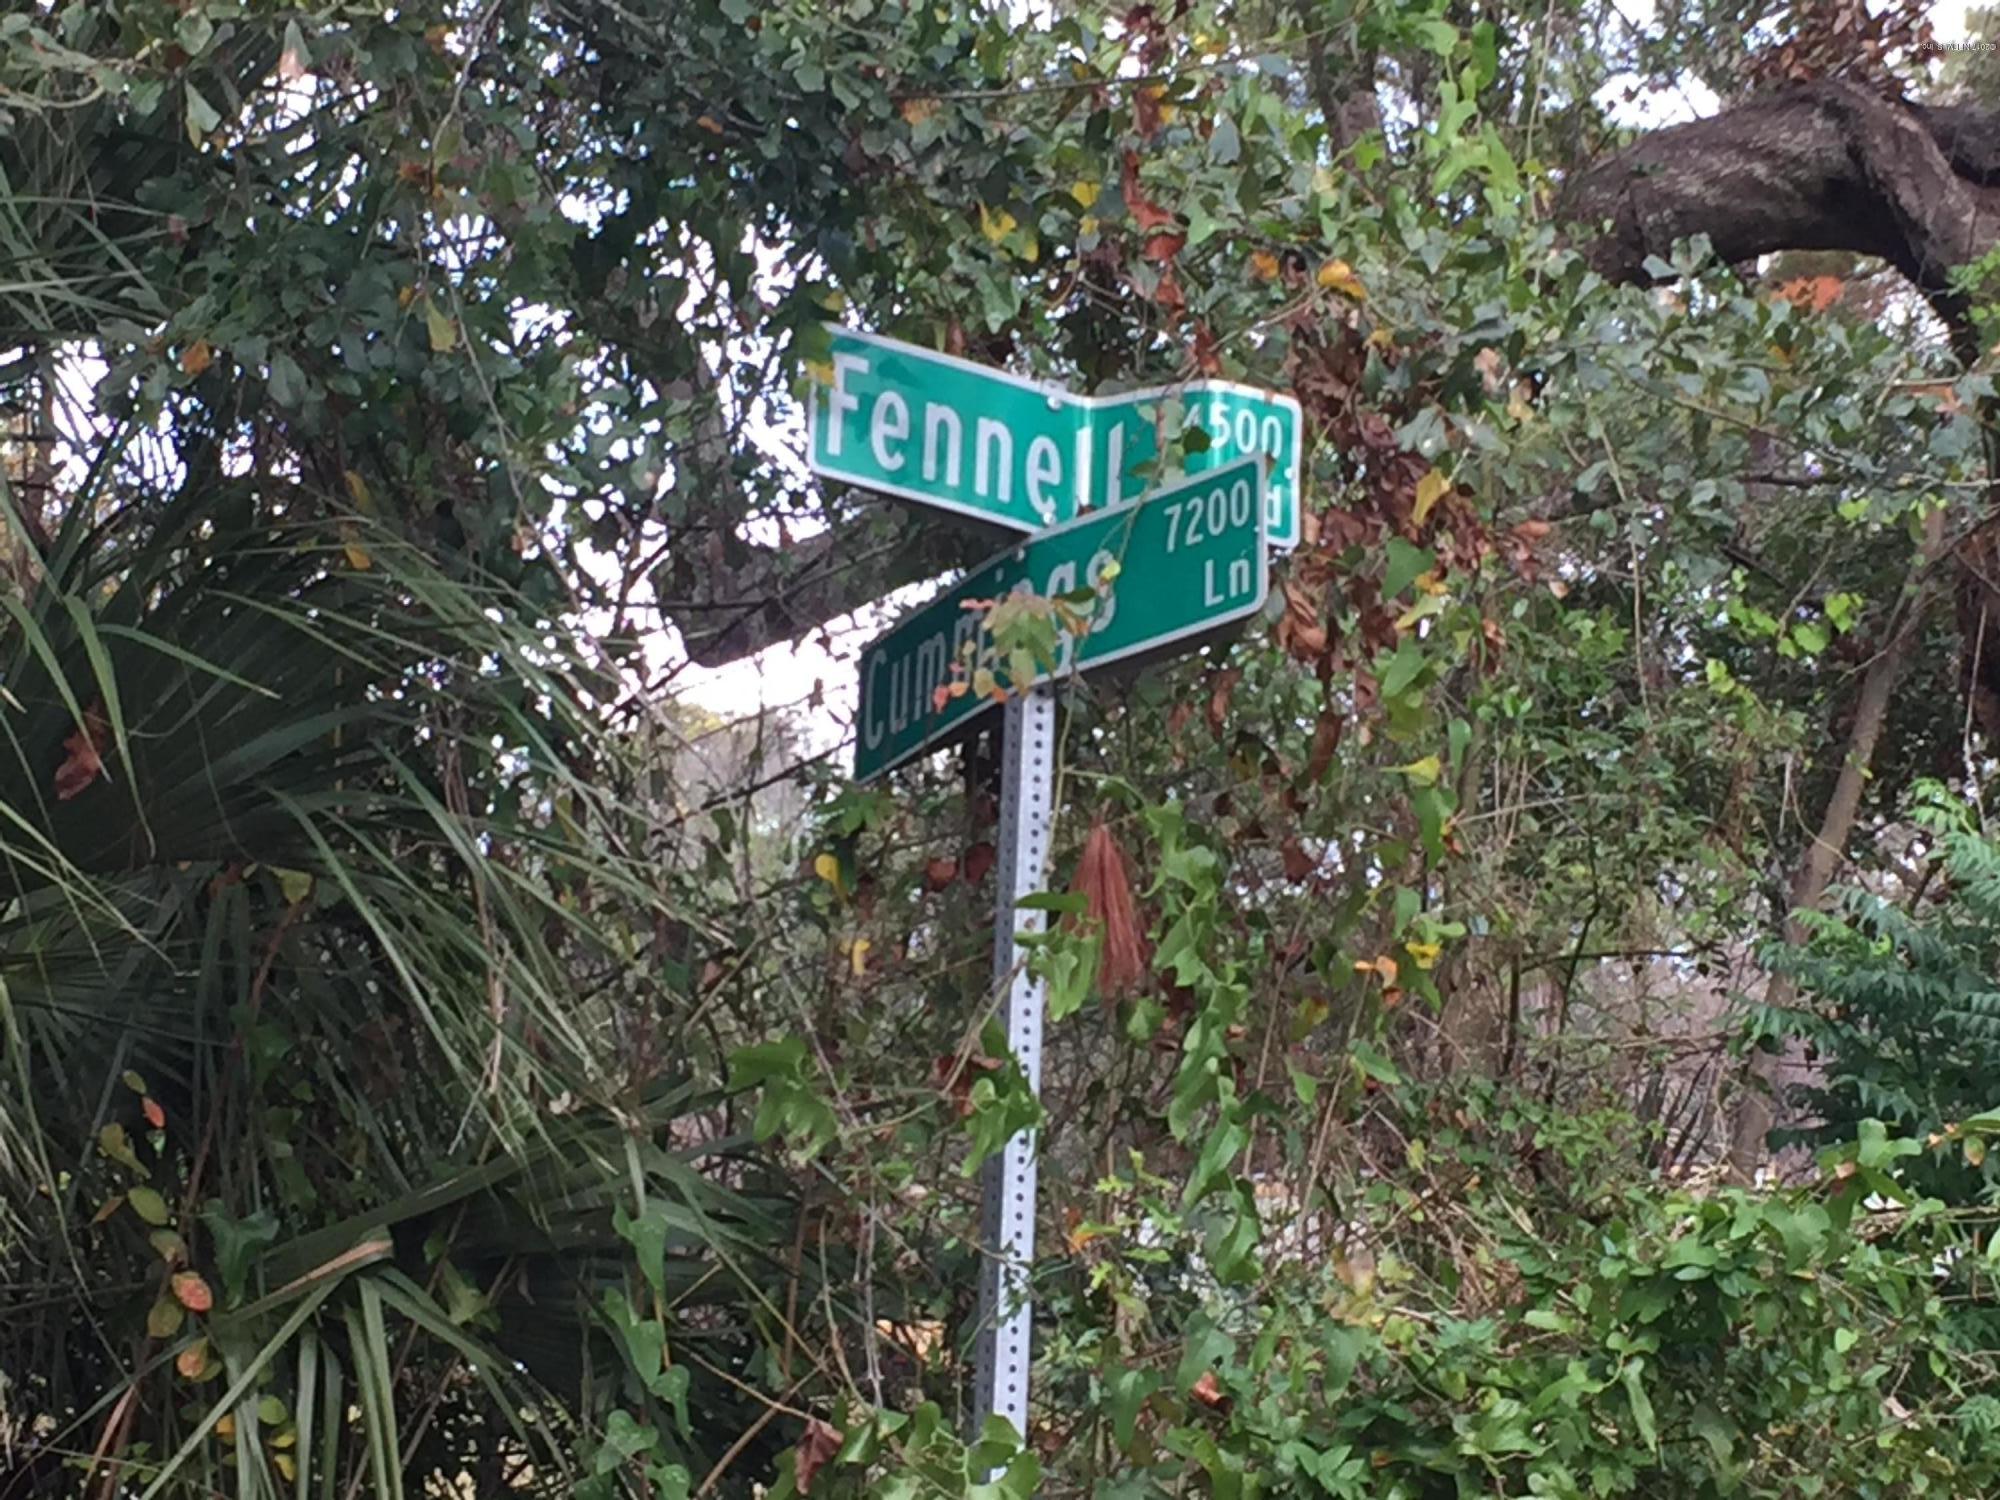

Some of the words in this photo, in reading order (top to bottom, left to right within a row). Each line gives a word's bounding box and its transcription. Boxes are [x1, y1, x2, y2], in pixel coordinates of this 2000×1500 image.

[826, 352, 1123, 514] Fennell
[1163, 479, 1250, 553] 7200
[1203, 559, 1250, 608] Ln
[864, 549, 1116, 750] Cummgs
